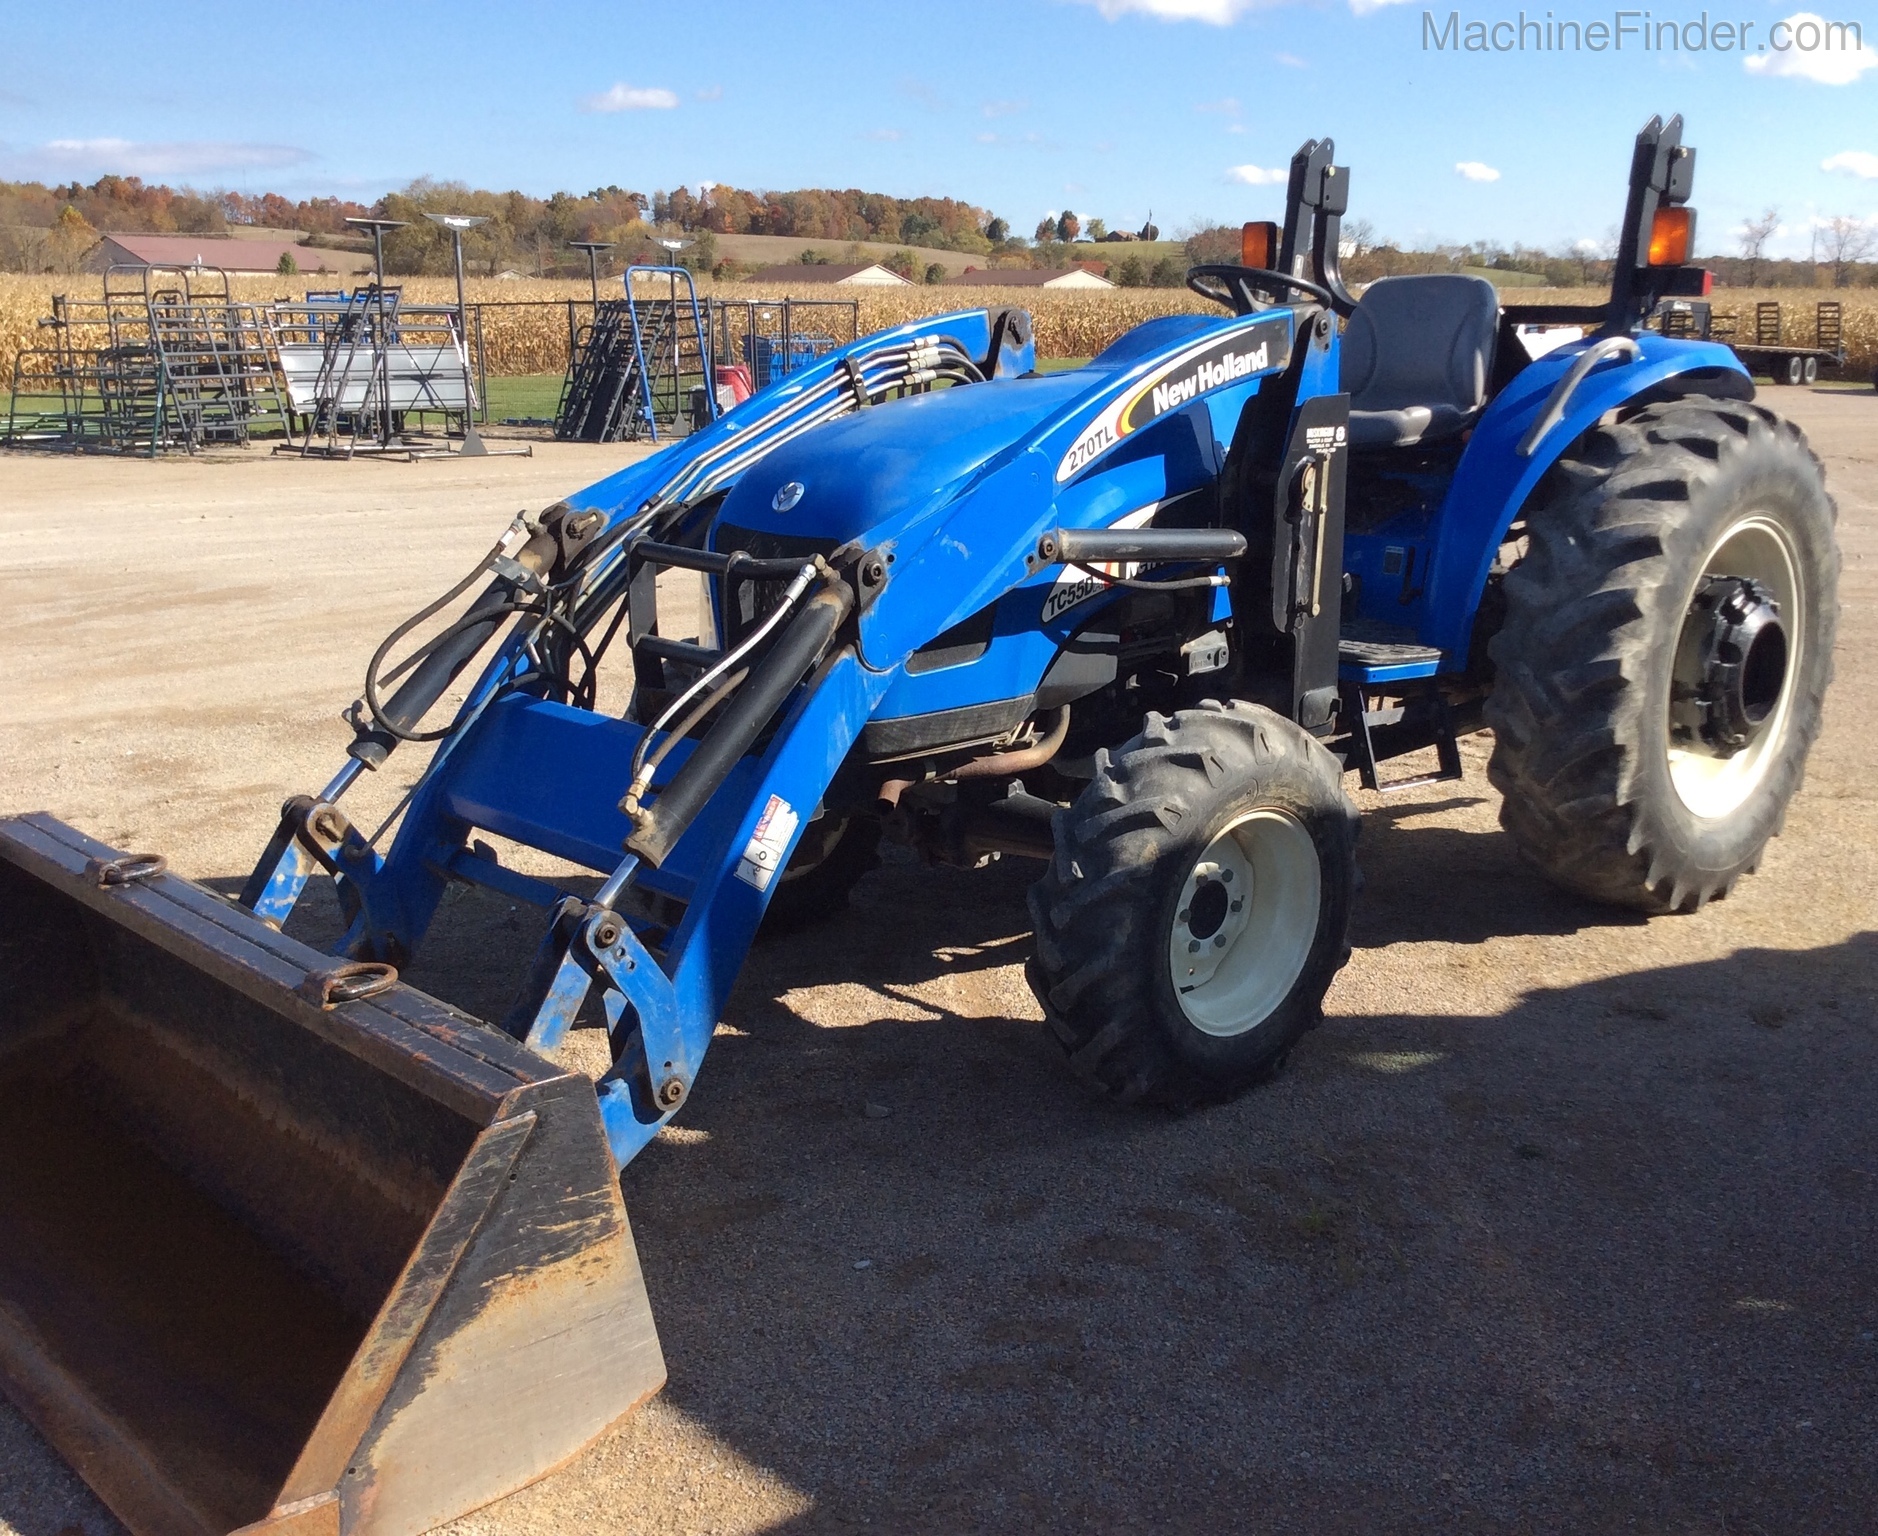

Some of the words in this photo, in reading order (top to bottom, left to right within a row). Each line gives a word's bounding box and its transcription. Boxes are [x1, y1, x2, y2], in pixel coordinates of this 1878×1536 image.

[1152, 374, 1197, 415] New
[1197, 341, 1268, 393] Holland
[1068, 426, 1113, 472] 270TL
